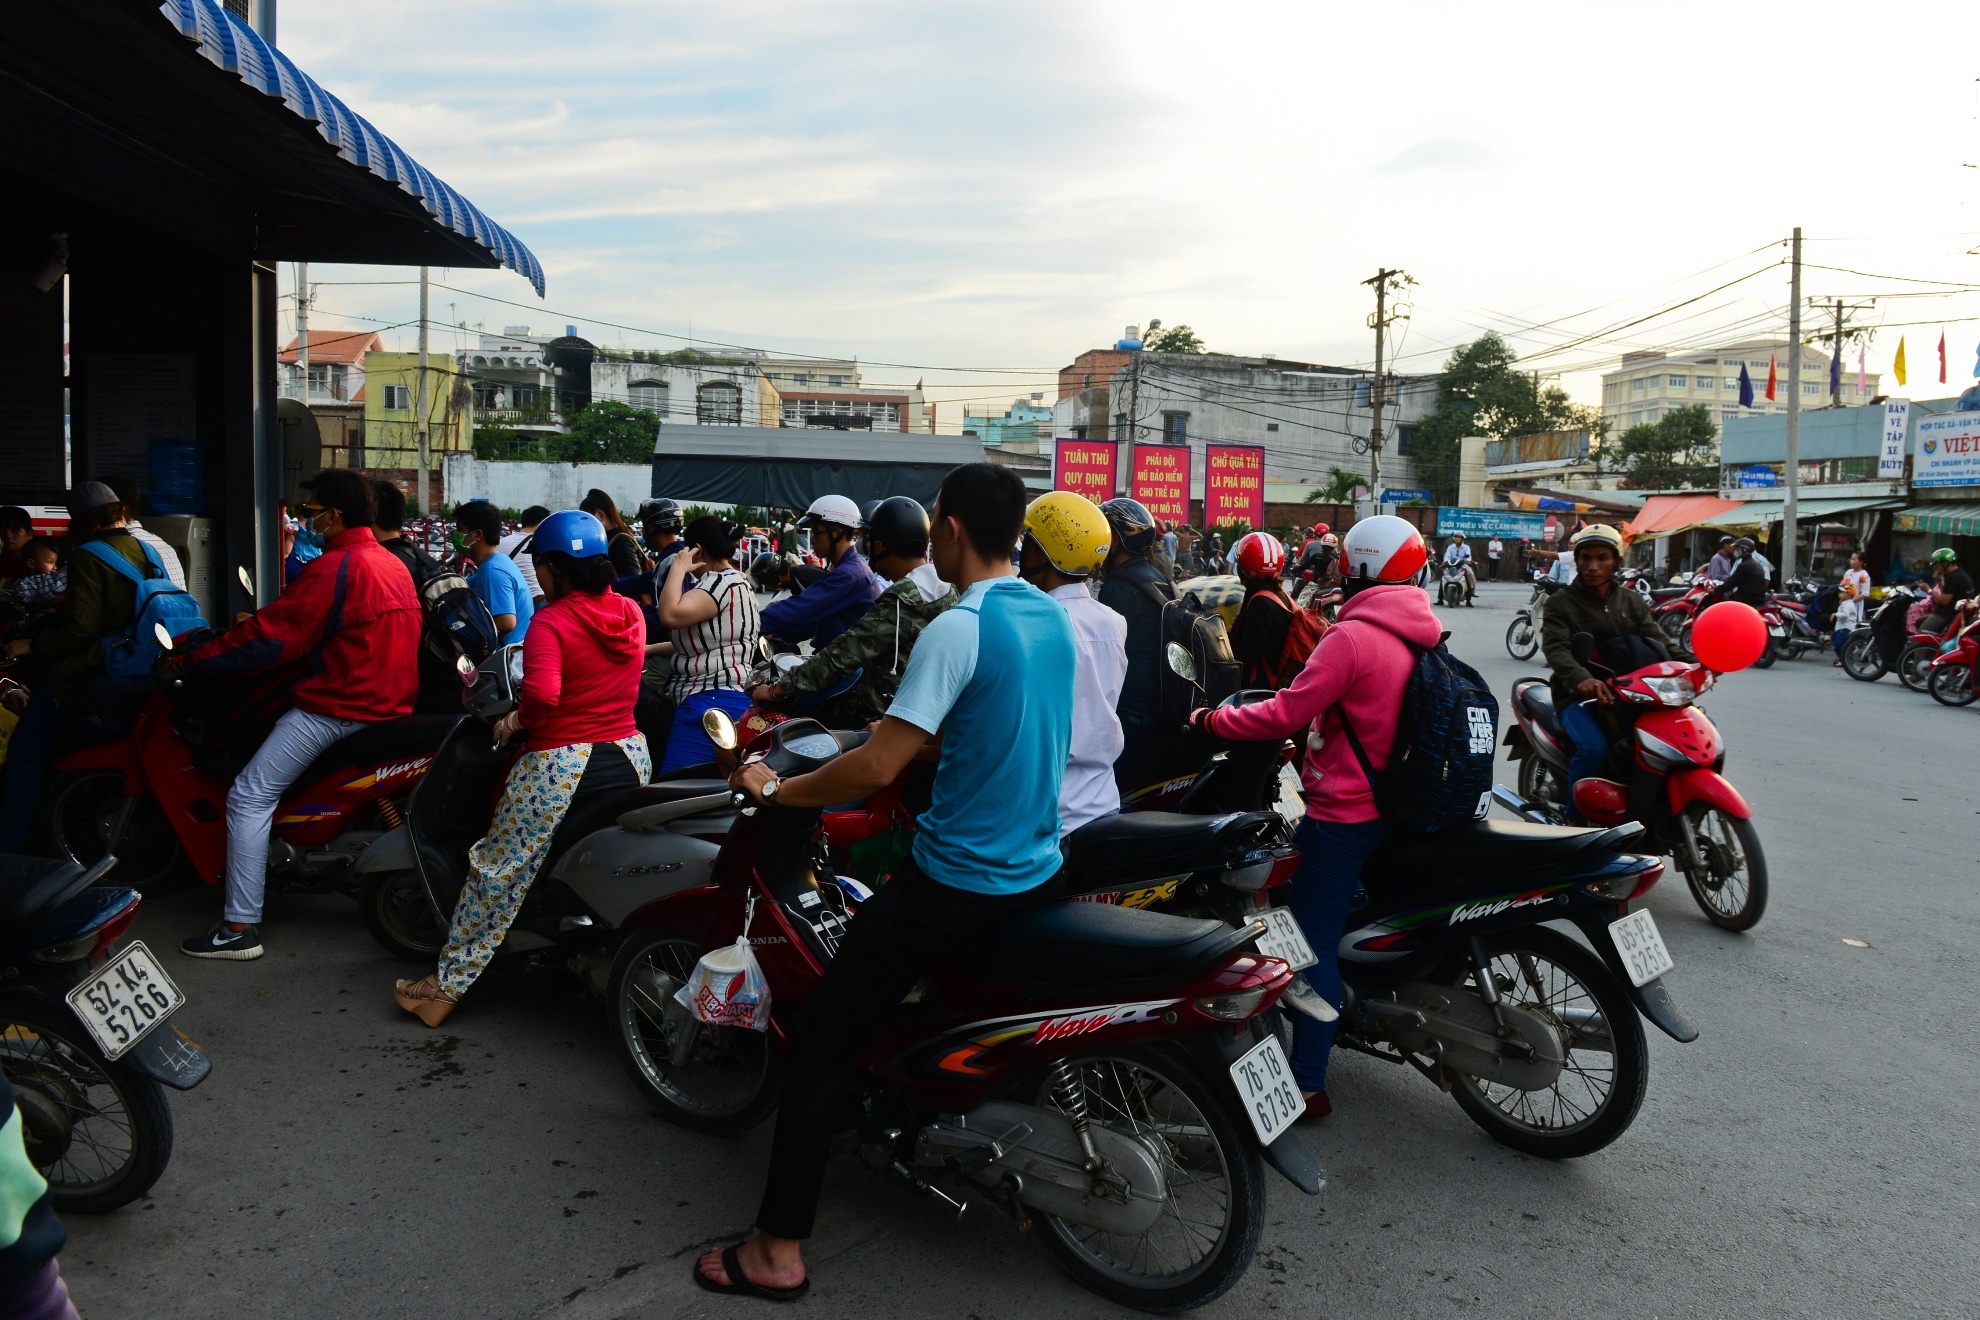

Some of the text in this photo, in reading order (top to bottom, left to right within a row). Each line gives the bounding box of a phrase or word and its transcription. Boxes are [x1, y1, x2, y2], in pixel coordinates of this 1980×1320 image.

[1886, 430, 1904, 443] TẬP
[1943, 432, 1980, 456] VIỆT
[1064, 448, 1109, 466] TUÂN THỦ
[1887, 446, 1898, 455] XE
[1145, 452, 1175, 468] PHẢI ĐỘI
[1211, 451, 1259, 470] CHỞ QUÁ TẢI
[1880, 458, 1903, 469] BUÝT
[1064, 471, 1107, 488] QUY ĐỊNH
[1137, 467, 1183, 483] MŨ BẢO HIỂM
[1211, 472, 1258, 491] LÀ PHÁ HOẠI
[1139, 484, 1180, 498] CHO TRẺ EM
[1219, 492, 1249, 509] TÀI SẢN
[1467, 706, 1491, 723] CON
[1468, 722, 1494, 738] VER
[375, 757, 433, 782] Wave
[1448, 900, 1518, 927] Wave
[749, 936, 788, 945] ONDA
[1617, 916, 1654, 951] 65-P3
[1631, 943, 1667, 979] 6256
[106, 983, 169, 1043] 5266
[1034, 1014, 1116, 1045] Wave
[1238, 1045, 1282, 1098] 76-T8
[1256, 1080, 1297, 1133] 6736
